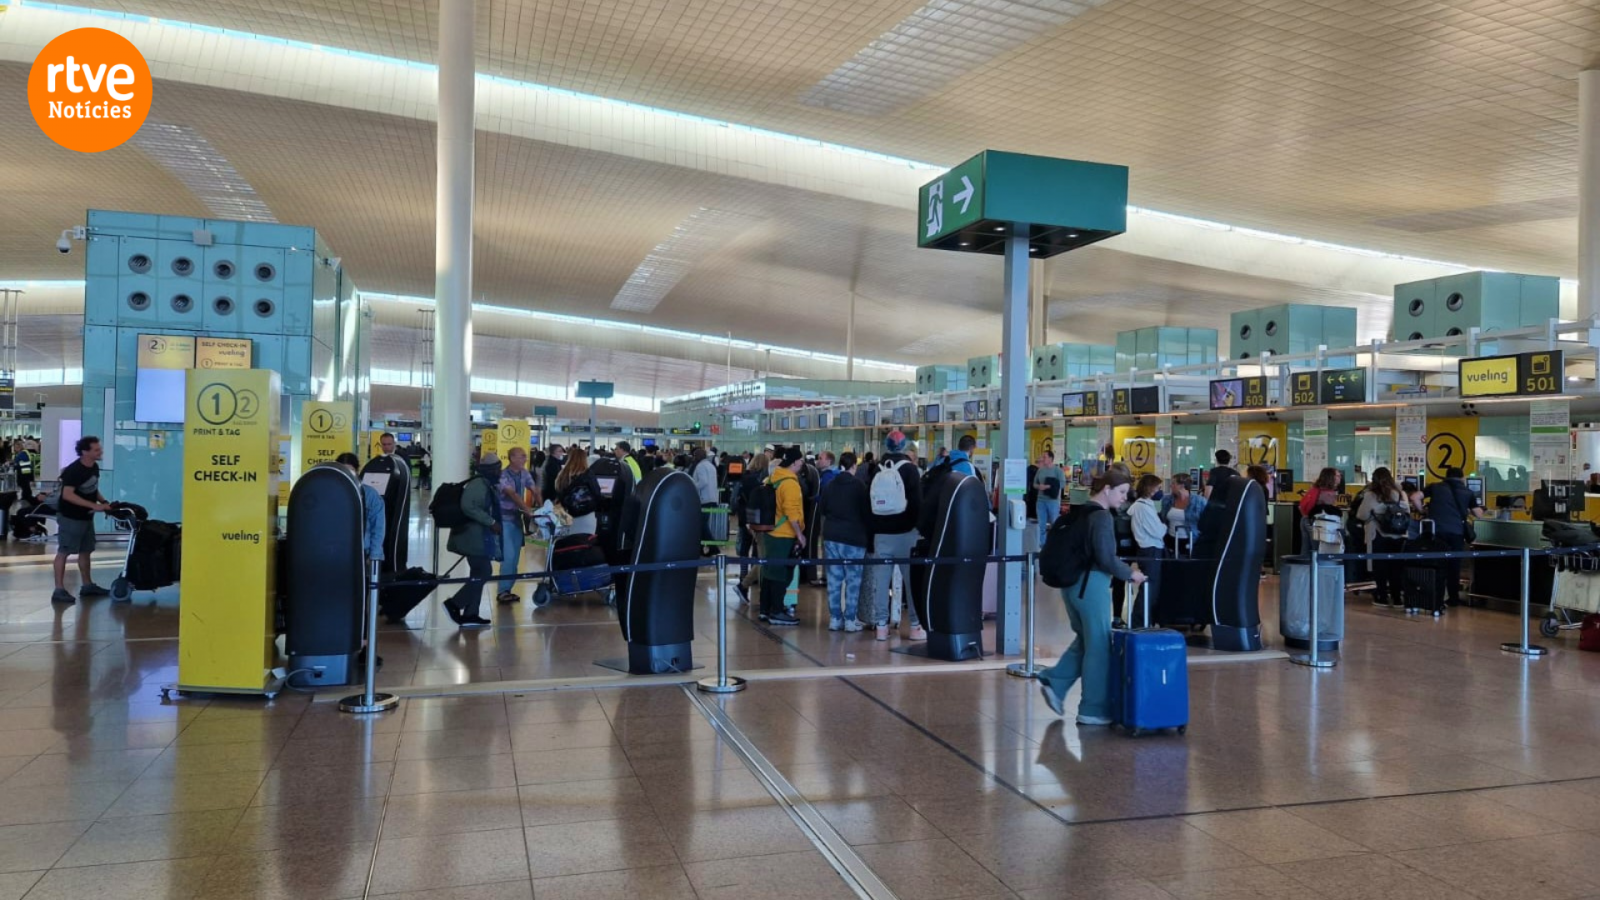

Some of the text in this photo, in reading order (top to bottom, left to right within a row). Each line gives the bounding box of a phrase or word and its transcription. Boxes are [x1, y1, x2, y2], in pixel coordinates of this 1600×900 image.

[219, 349, 245, 357] vueling
[1467, 369, 1508, 384] vueling
[1526, 377, 1556, 392] 501
[1245, 395, 1264, 407] 503
[1294, 391, 1315, 404] 502
[211, 393, 250, 416] 1 2
[1114, 404, 1127, 413] 504
[318, 415, 323, 428] 1
[193, 428, 241, 436] PRINT & TAG
[1136, 443, 1143, 461] 2
[1259, 443, 1269, 464] 2
[1438, 443, 1453, 469] 2
[211, 454, 241, 466] SELF
[193, 470, 257, 482] CHECK-IN
[221, 530, 260, 544] vueling
